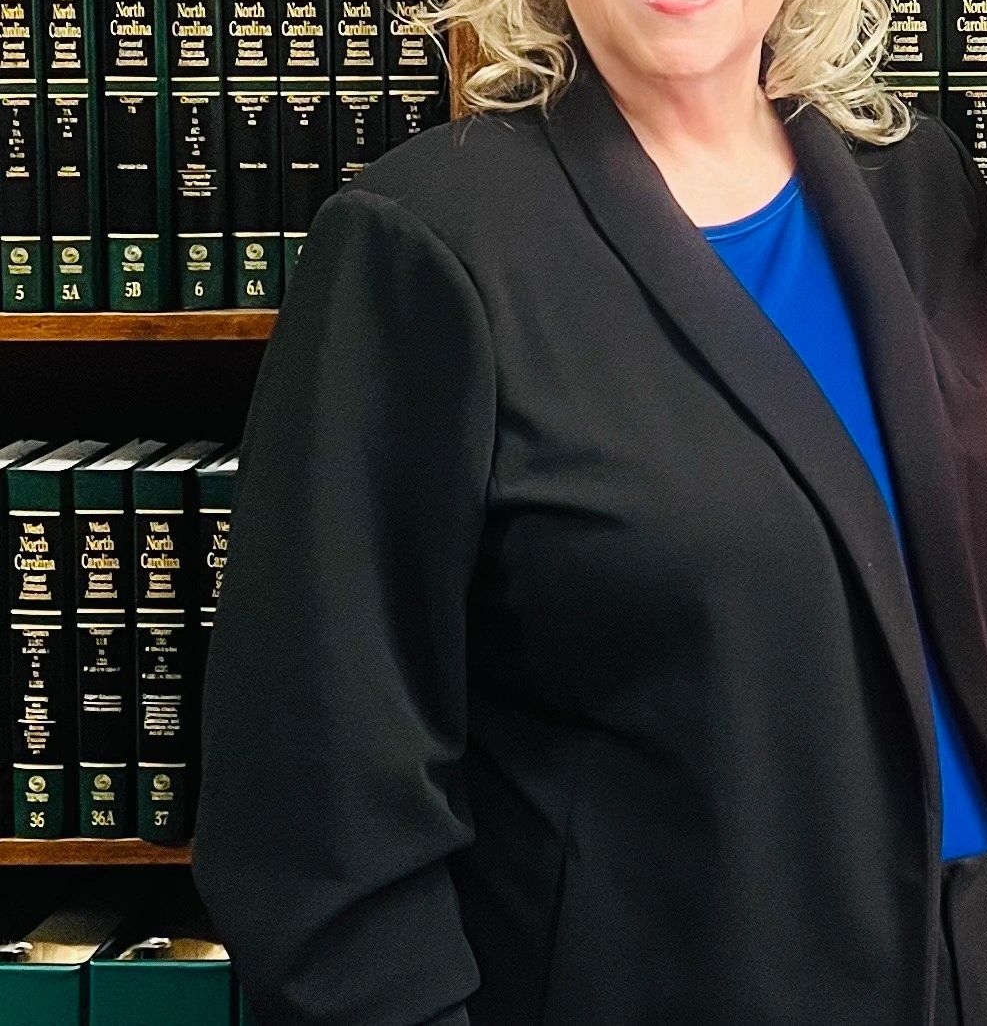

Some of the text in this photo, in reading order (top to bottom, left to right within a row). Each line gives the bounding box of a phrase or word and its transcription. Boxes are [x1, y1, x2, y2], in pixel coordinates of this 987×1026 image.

[1, 3, 24, 19] North
[53, 4, 76, 19] North
[116, 2, 144, 17] North
[177, 2, 206, 18] North
[235, 2, 264, 18] North
[287, 2, 316, 17] North
[344, 2, 371, 17] North
[397, 2, 427, 17] North
[49, 22, 81, 38] Carolina
[111, 20, 152, 35] Carolina
[172, 21, 213, 36] Carolina
[229, 20, 272, 36] Carolina
[282, 20, 323, 36] Carolina
[338, 20, 377, 36] Carolina
[15, 285, 24, 300] 5
[62, 284, 80, 300] 5A
[125, 282, 141, 297] 5B
[195, 281, 203, 296] 6
[247, 280, 265, 295] 6A
[20, 536, 48, 552] North
[85, 535, 114, 550] North
[146, 535, 173, 550] North
[15, 554, 55, 570] Carolina
[81, 553, 120, 569] Carolina
[141, 553, 180, 568] Carolina
[30, 812, 44, 827] 36
[92, 811, 115, 825] 36A
[155, 811, 168, 825] 37
